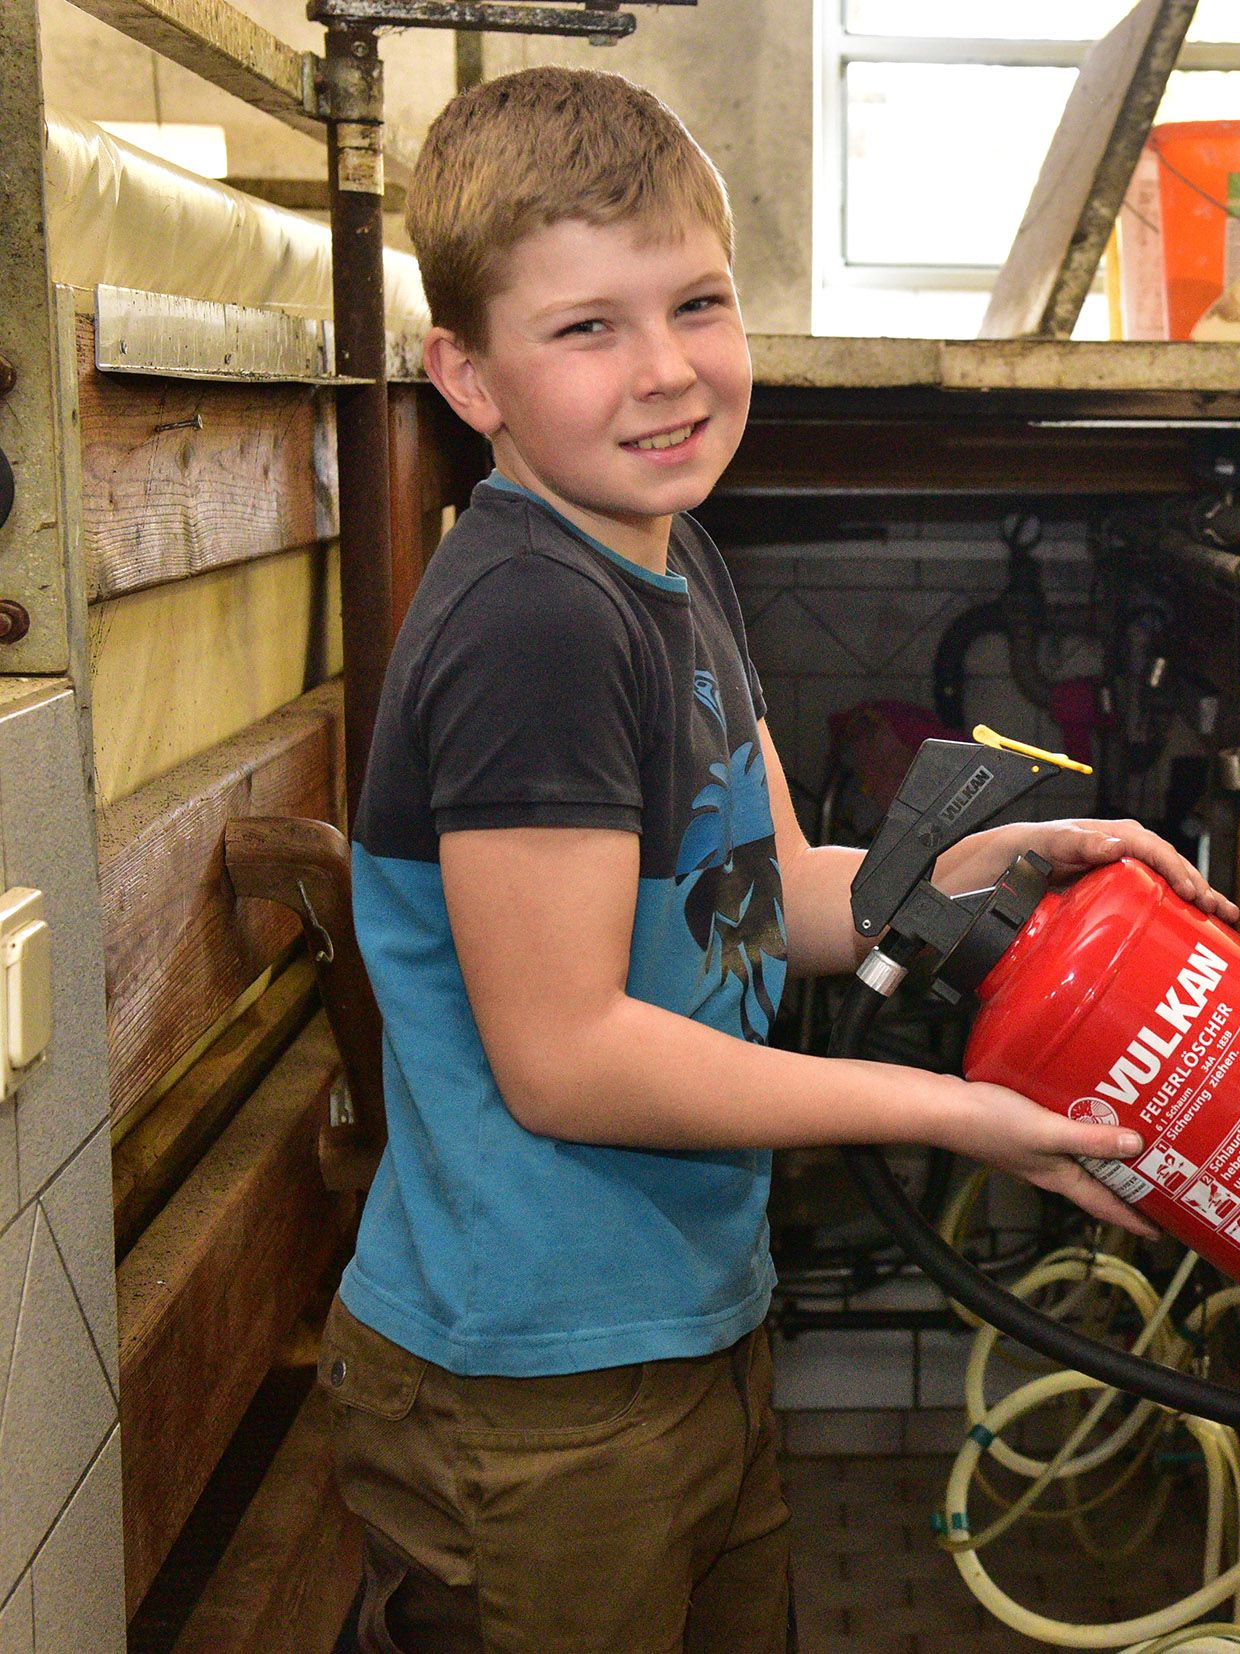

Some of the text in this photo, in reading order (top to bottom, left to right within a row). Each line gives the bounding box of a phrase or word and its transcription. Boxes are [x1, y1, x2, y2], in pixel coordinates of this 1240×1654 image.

[940, 766, 993, 823] VULKAN
[1094, 941, 1228, 1104] VULKAN
[1139, 1002, 1232, 1123] FEUERLÖSCHER
[1165, 1087, 1193, 1118] Schaum
[1200, 1056, 1216, 1072] 34A
[1216, 1030, 1232, 1049] 183B
[1166, 1050, 1239, 1140] Sicherung ziehen.
[1202, 1175, 1211, 1185] 2
